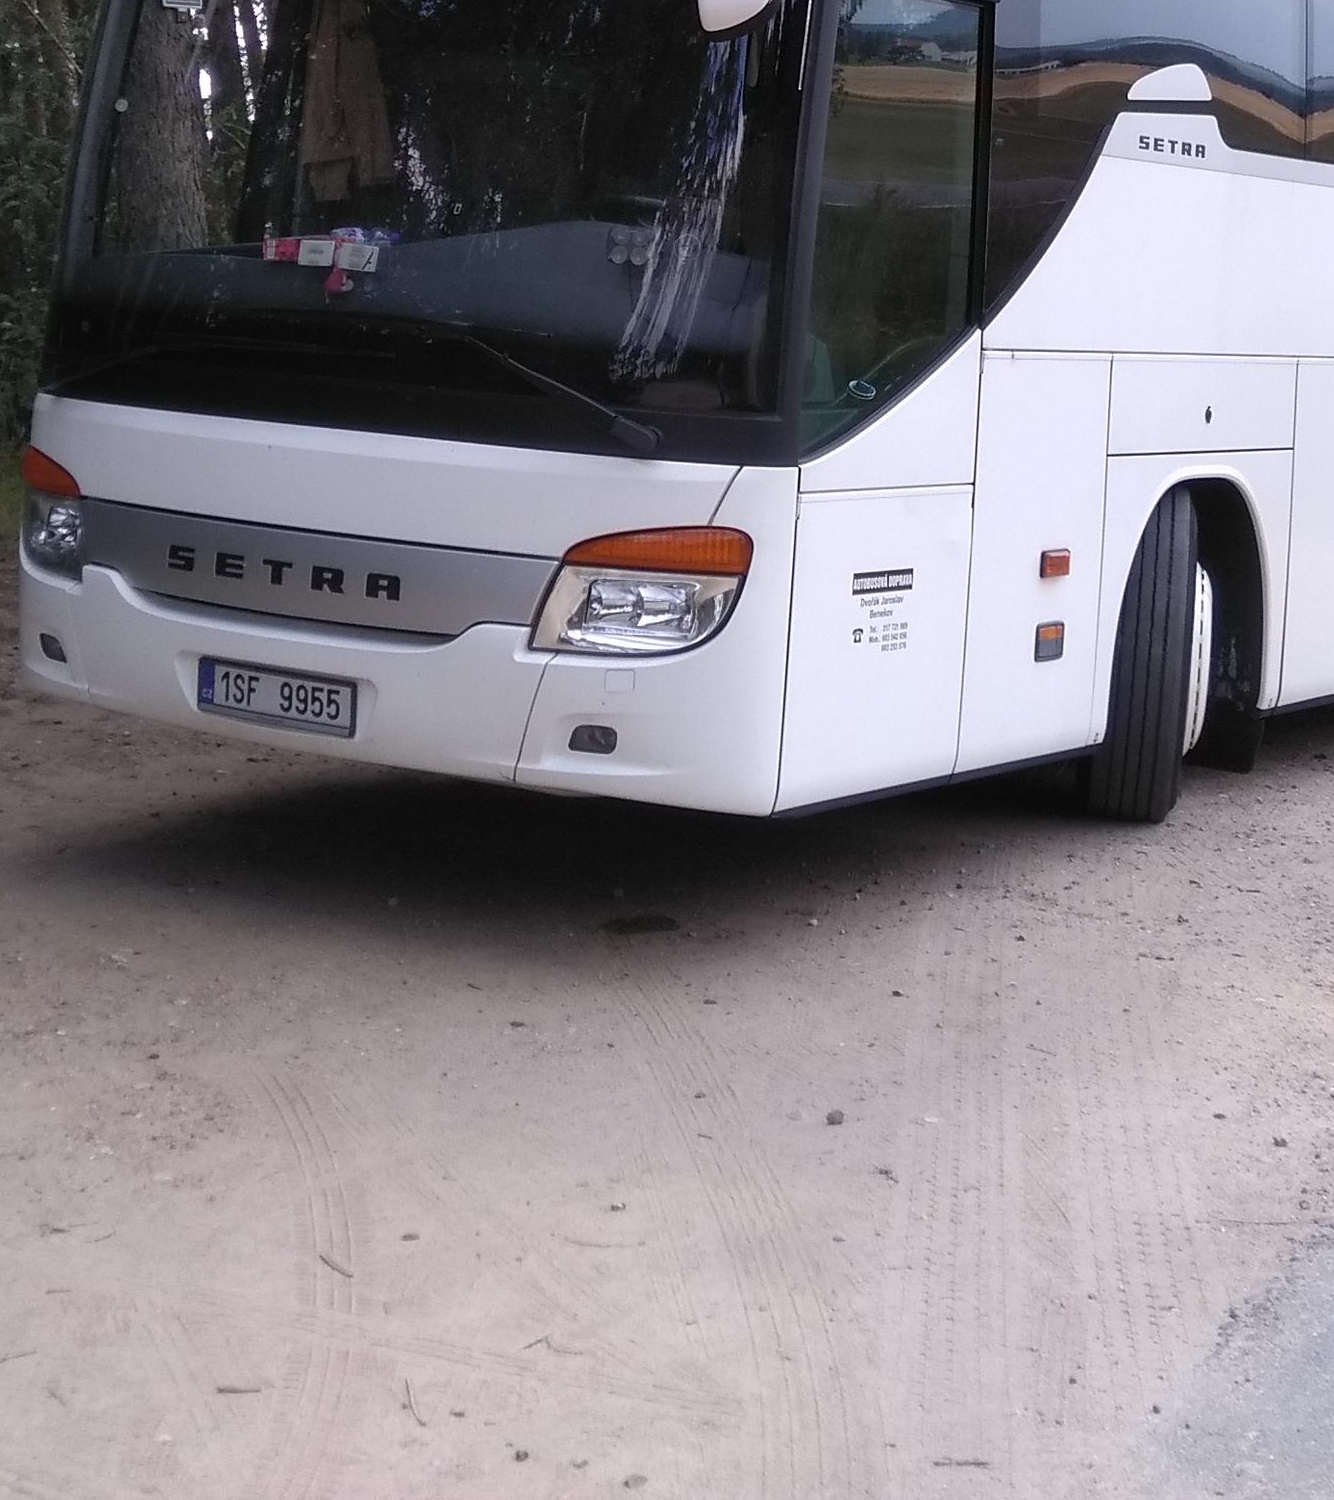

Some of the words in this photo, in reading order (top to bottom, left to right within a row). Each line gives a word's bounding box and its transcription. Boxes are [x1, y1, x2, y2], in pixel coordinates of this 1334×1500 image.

[1138, 135, 1206, 159] SETRA
[167, 544, 401, 601] SETRA
[202, 688, 213, 698] CZ
[221, 671, 260, 706] 1SF
[279, 682, 341, 721] 9955
